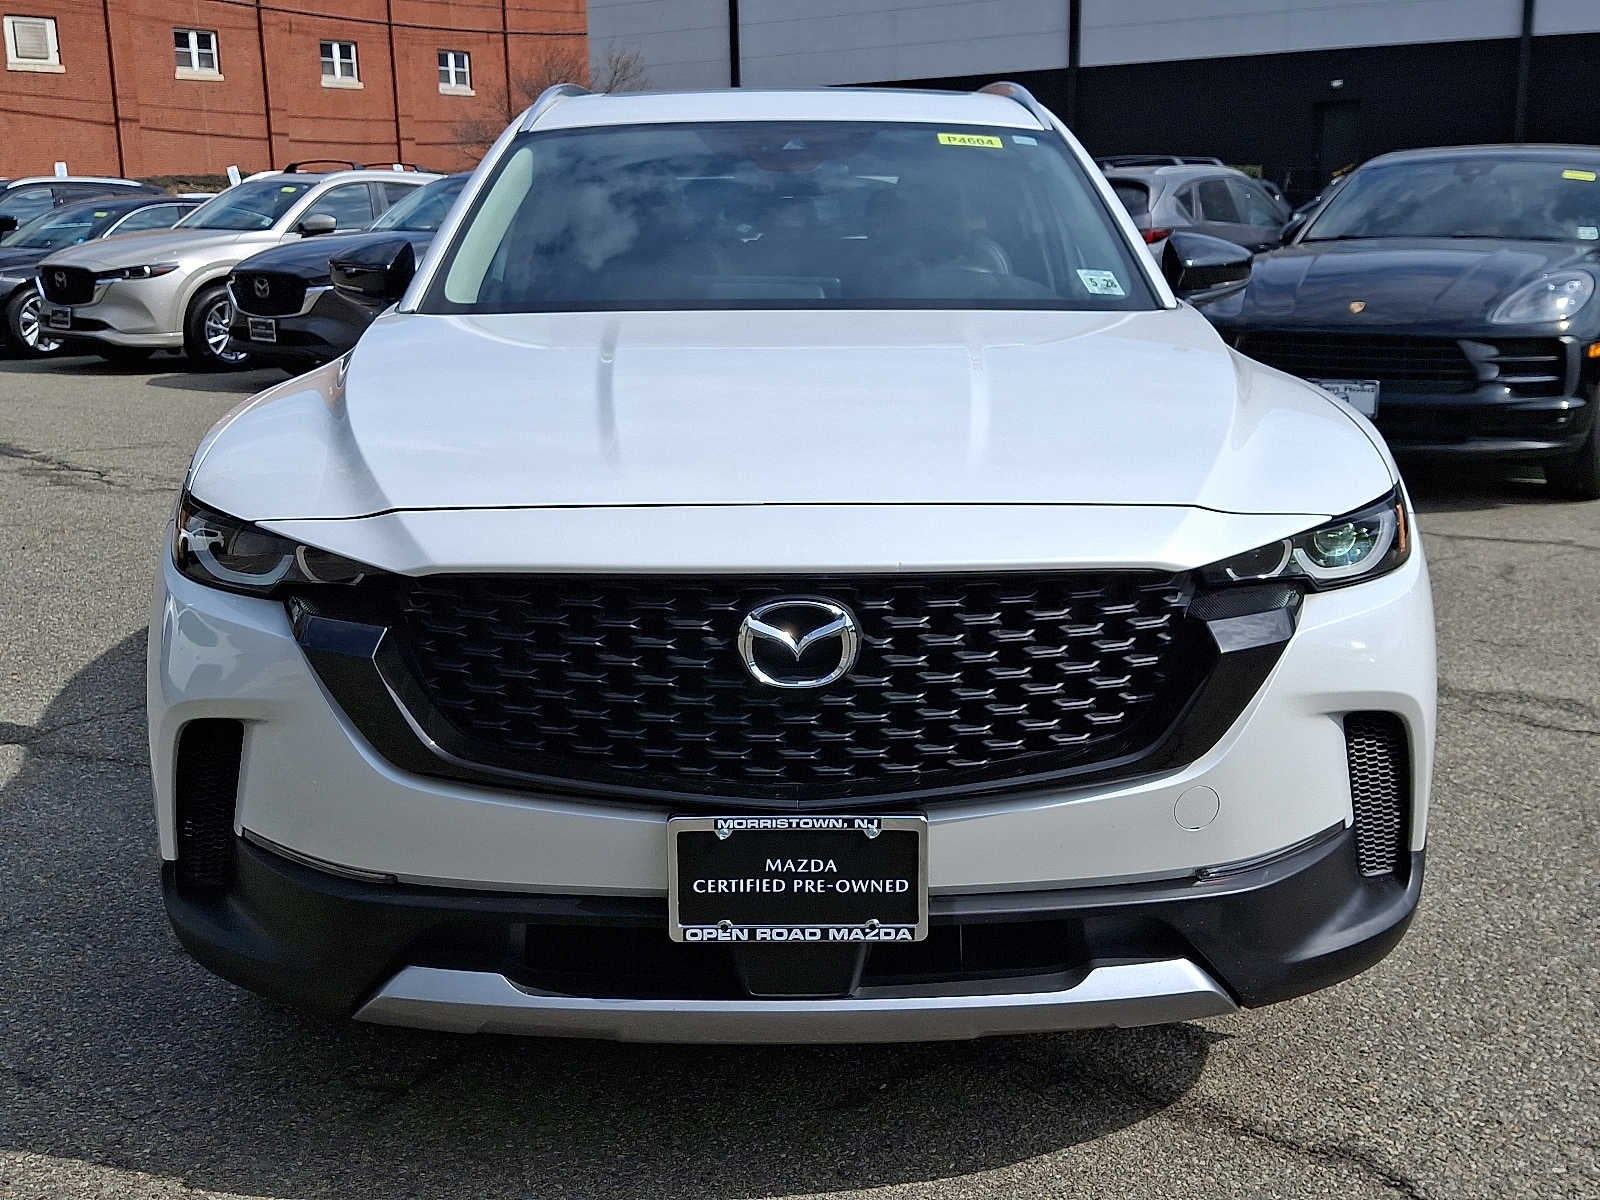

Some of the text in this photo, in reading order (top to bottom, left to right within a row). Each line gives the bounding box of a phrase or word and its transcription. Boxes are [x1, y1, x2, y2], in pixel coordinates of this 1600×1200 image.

[947, 136, 994, 146] P4604
[717, 819, 878, 829] MORRISTOWN, NJ
[765, 859, 837, 872] MAZDA
[693, 879, 909, 893] CERTIFIED PRE-OWNED
[686, 928, 912, 941] OPEN ROAD MAZDA
